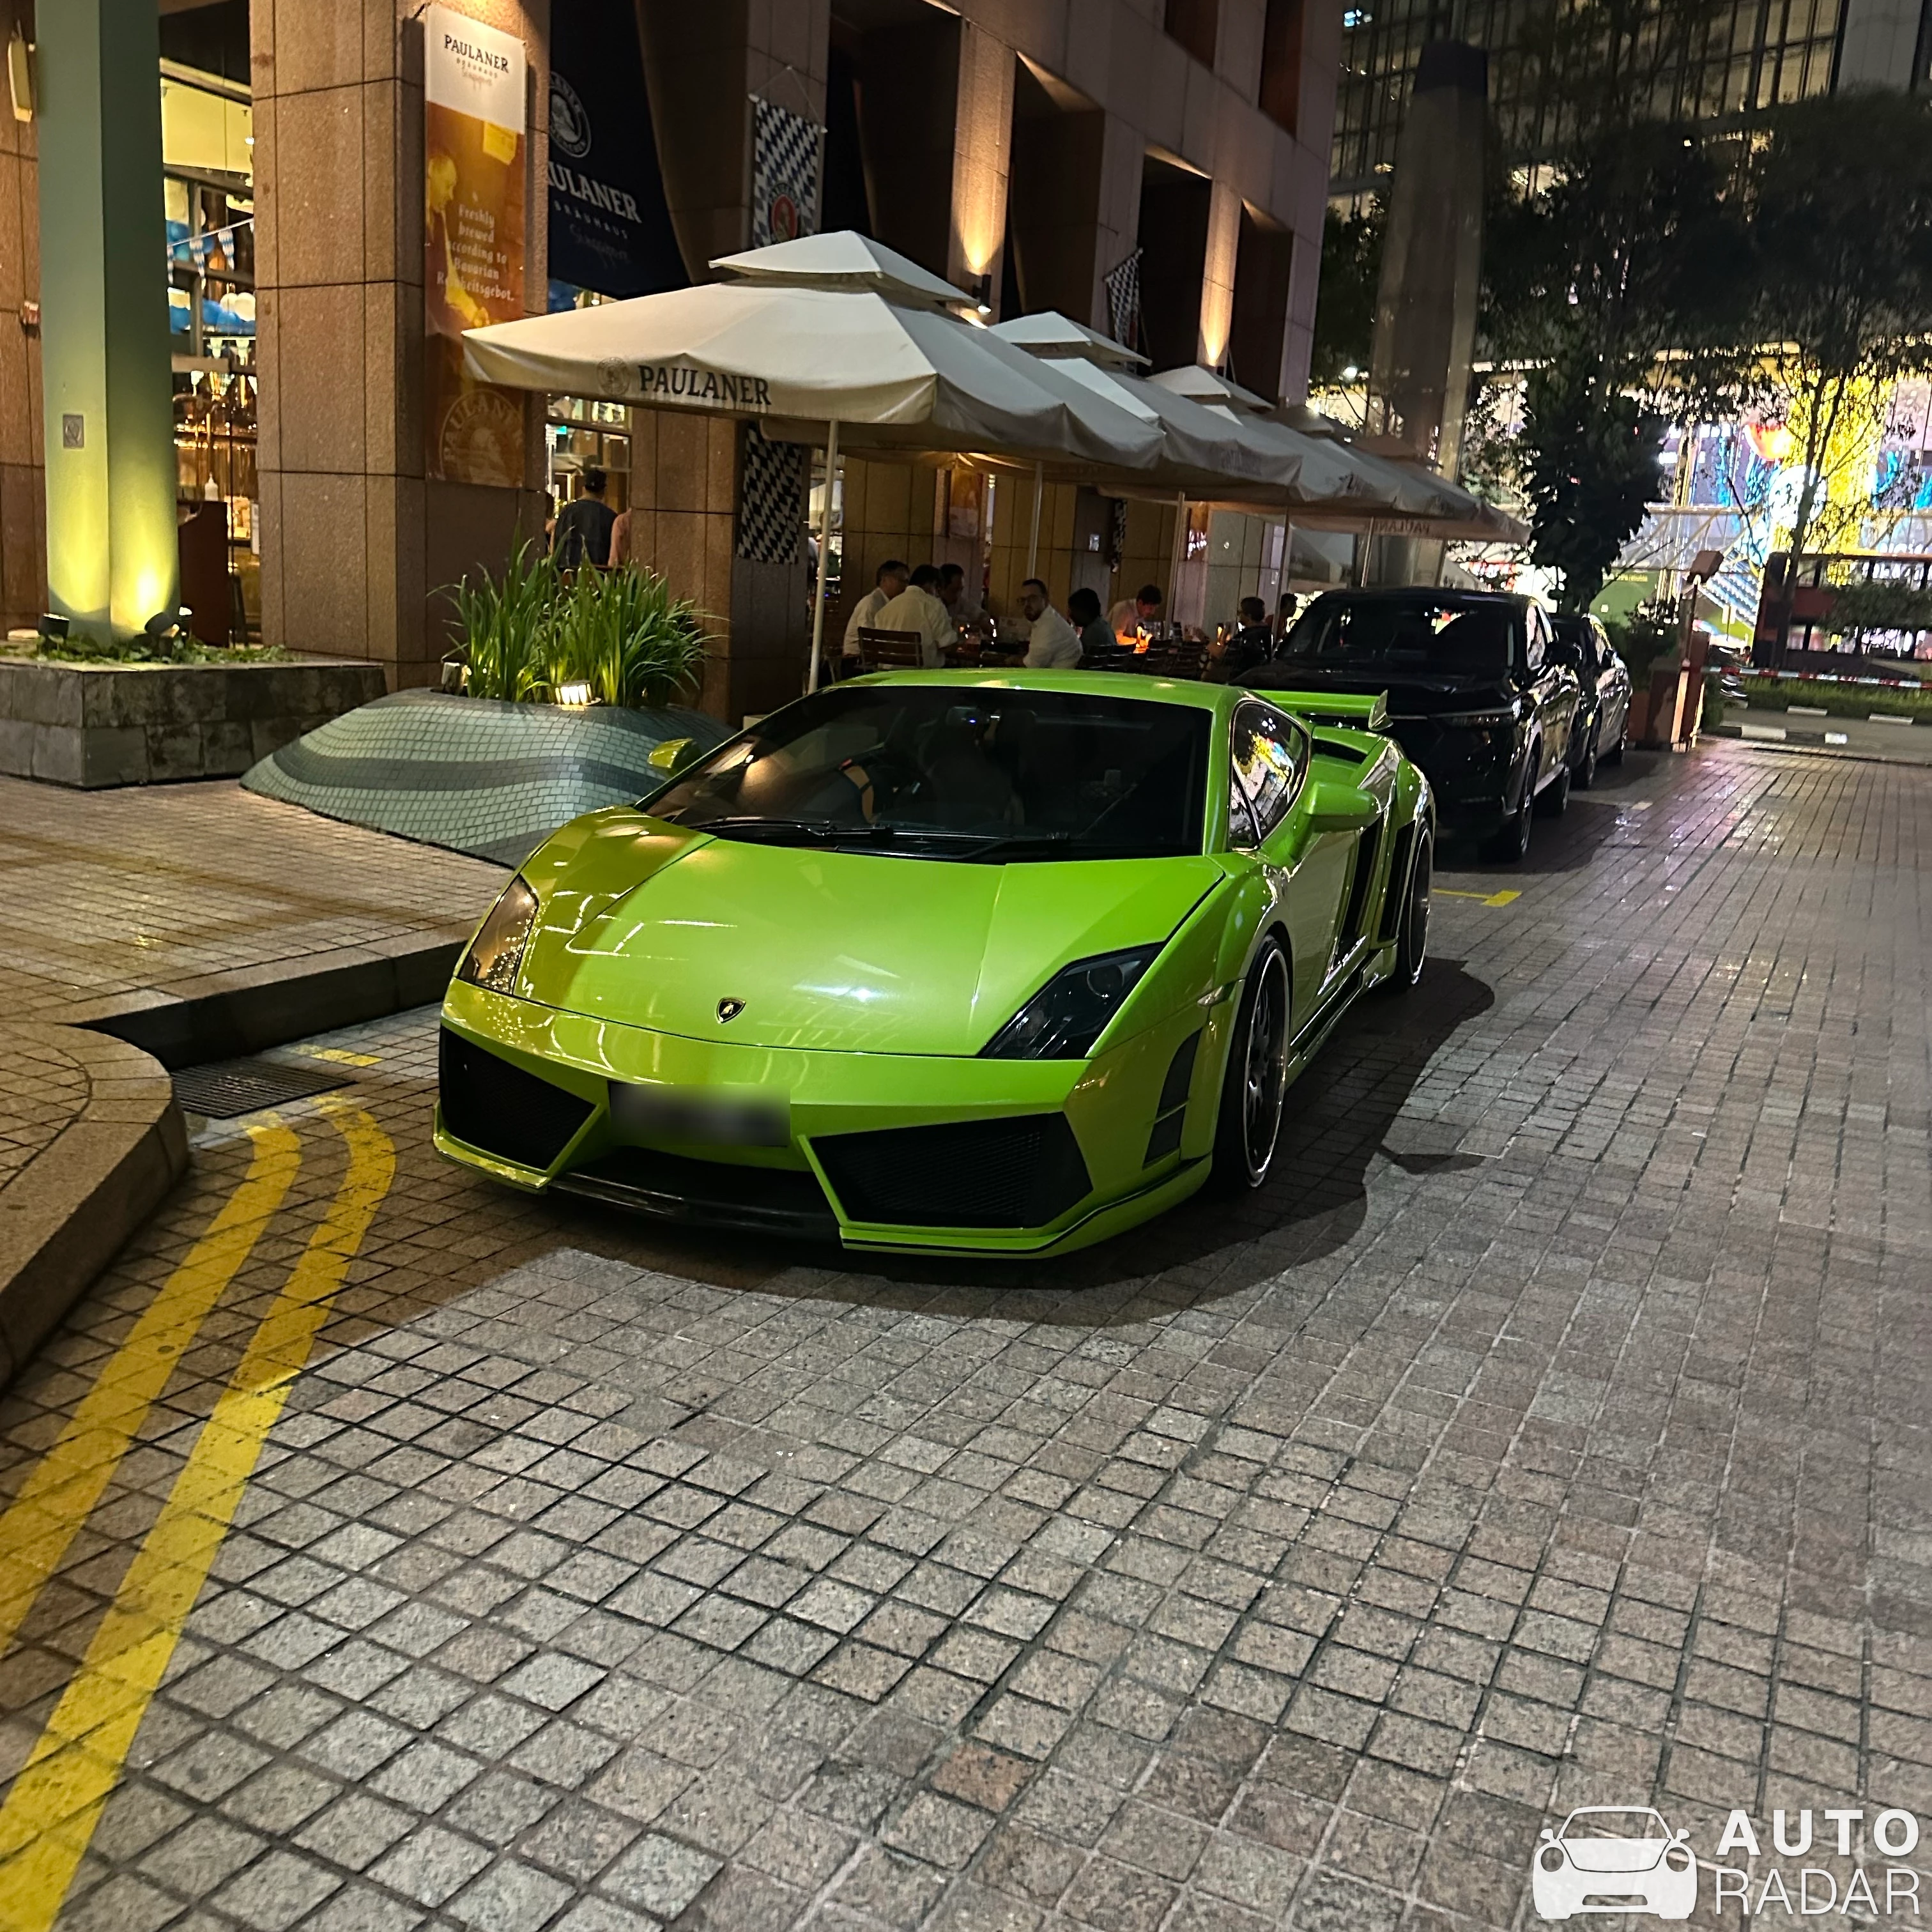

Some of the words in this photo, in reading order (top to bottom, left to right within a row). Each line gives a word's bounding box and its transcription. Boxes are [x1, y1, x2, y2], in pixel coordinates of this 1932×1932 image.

[444, 34, 509, 73] PAULANER
[548, 160, 642, 224] ULANER
[459, 204, 494, 229] Freshly
[459, 222, 494, 243] brewed
[448, 241, 494, 264] ccording
[496, 252, 507, 264] to
[454, 257, 500, 280] Bavarian
[639, 365, 772, 405] PAULANER
